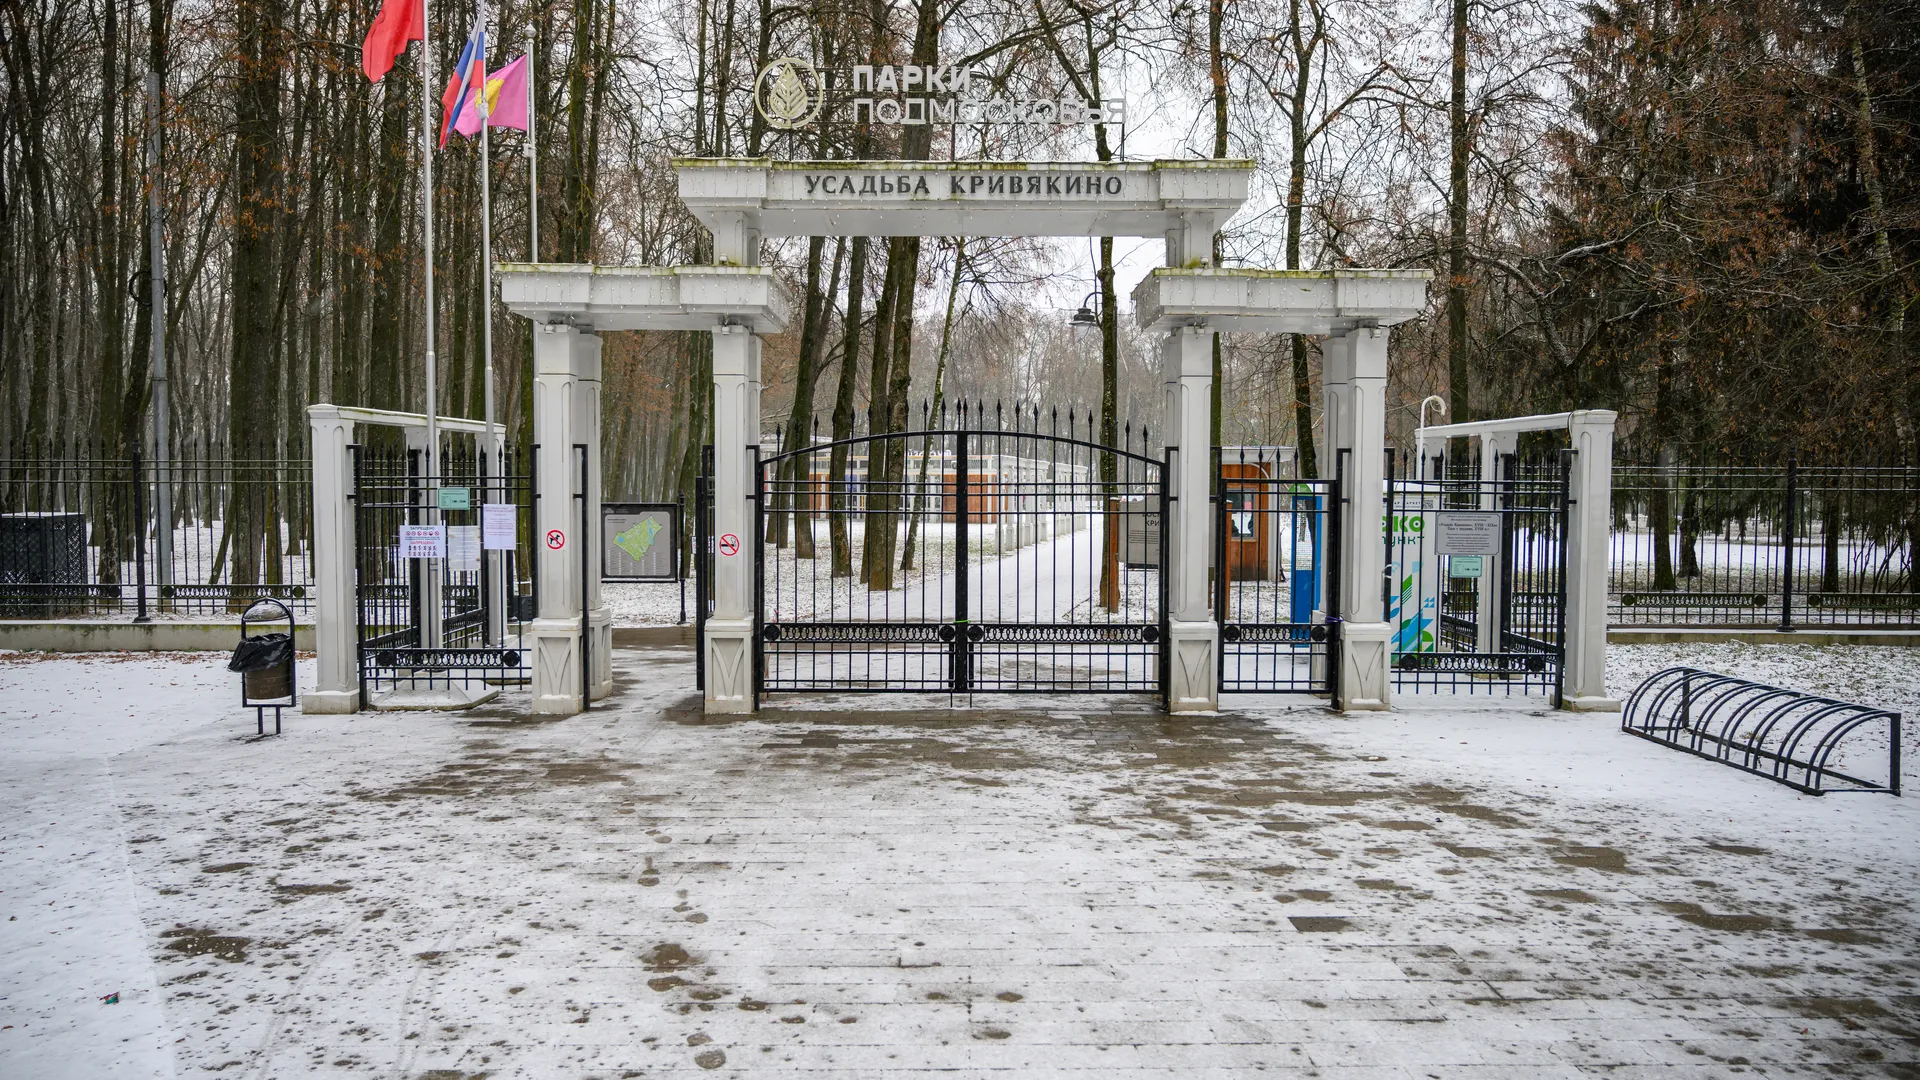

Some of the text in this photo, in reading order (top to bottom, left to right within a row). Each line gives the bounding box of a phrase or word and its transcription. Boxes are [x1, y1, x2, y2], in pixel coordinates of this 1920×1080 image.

[853, 65, 970, 93] ПАРКИ
[853, 98, 1127, 125] ПОДМОСКОВЬЯ
[804, 175, 1123, 195] УСАДЬБА КРИВЯКИНО
